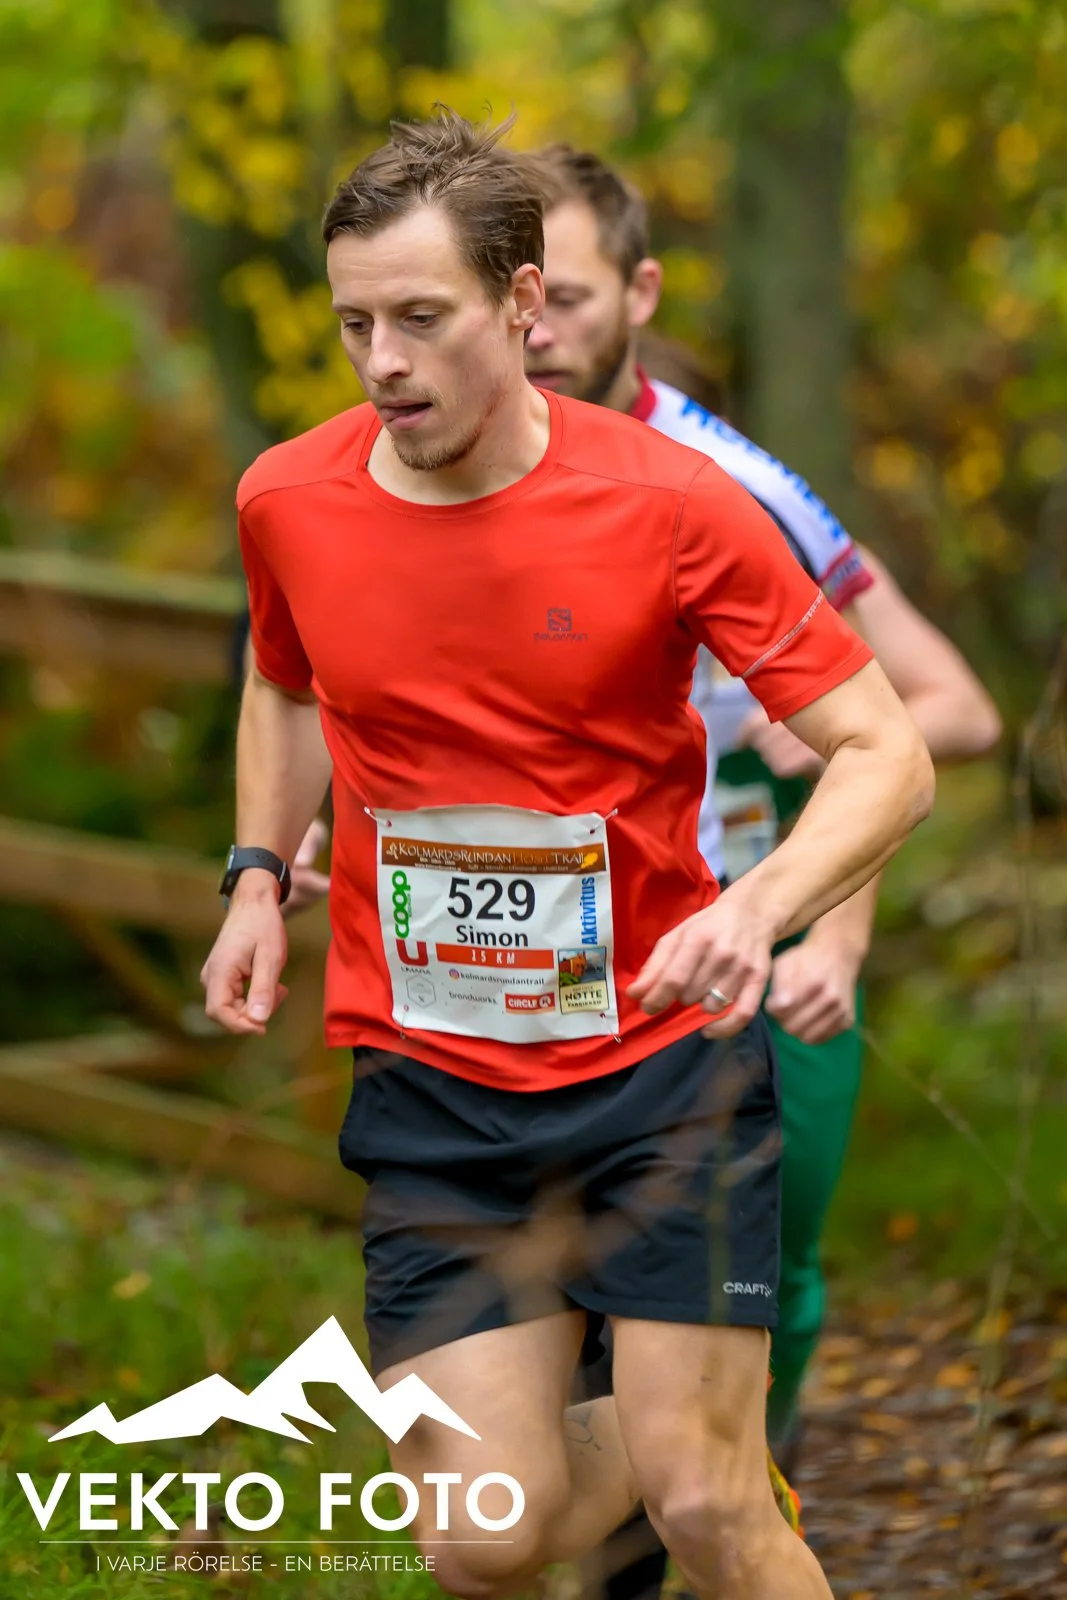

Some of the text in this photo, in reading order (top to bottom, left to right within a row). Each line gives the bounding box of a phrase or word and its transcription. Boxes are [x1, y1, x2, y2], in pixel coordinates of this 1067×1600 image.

[392, 870, 411, 940] coop
[447, 876, 536, 922] 529
[580, 876, 598, 945] Aktivitus
[456, 924, 529, 947] Simon
[496, 951, 515, 965] KM
[460, 972, 545, 985] kolmardsrundantrail
[508, 998, 538, 1008] CIRCLE
[722, 1281, 765, 1295] CRAFT
